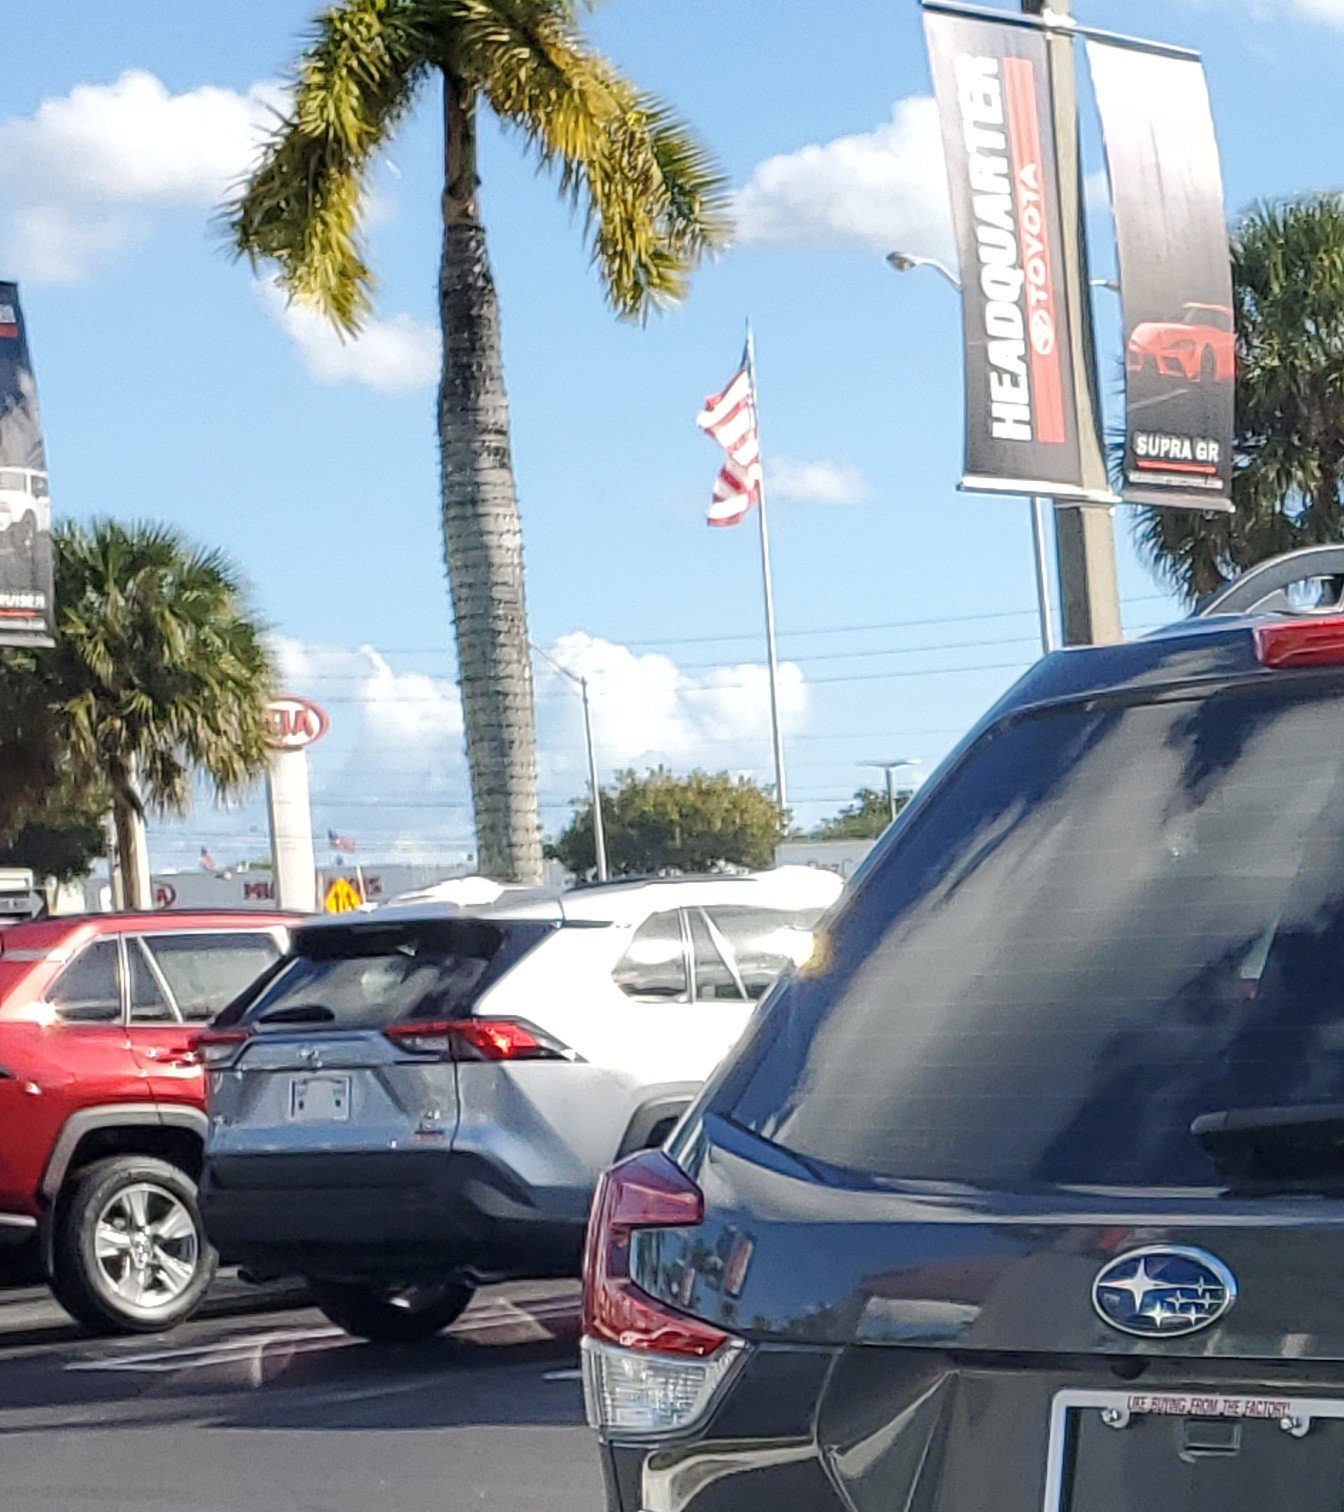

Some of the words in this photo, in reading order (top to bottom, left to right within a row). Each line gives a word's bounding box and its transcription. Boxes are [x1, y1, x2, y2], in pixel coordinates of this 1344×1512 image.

[954, 52, 1034, 442] HEADQUARTER
[1017, 163, 1055, 302] TOYOTA
[1135, 433, 1193, 460] SUPRA
[1196, 440, 1220, 463] GR
[1190, 1398, 1219, 1415] FROM
[1223, 1399, 1241, 1416] THE
